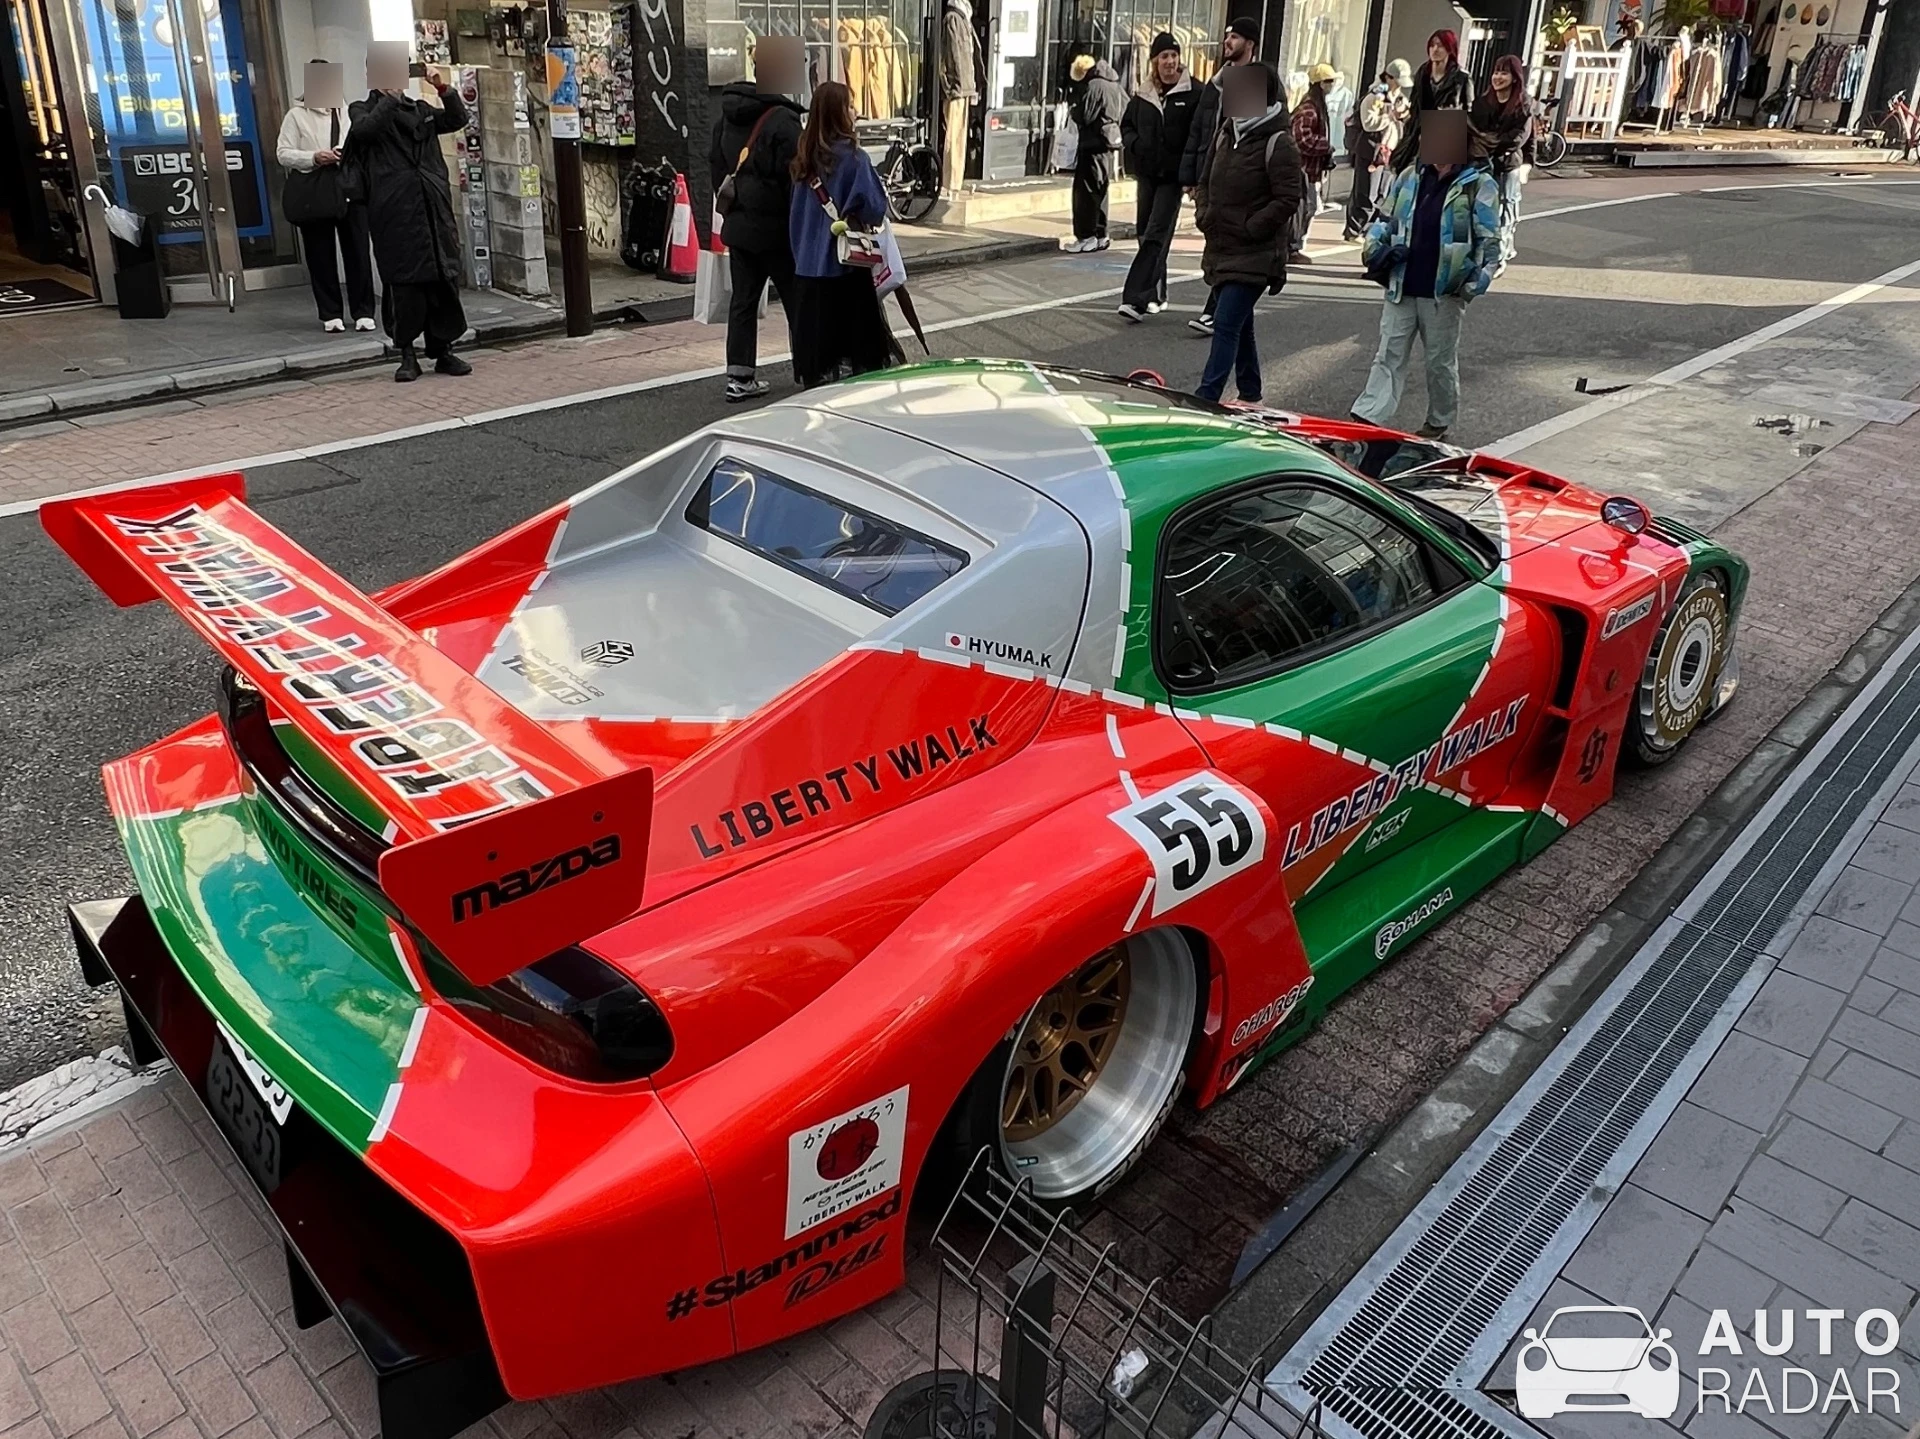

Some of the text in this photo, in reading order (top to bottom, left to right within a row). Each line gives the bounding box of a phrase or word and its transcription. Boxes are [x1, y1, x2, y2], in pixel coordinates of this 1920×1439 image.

[968, 636, 1053, 669] HYUMA.K
[690, 712, 1000, 860] LIBERTY WALK
[1280, 692, 1530, 873] LIBERTY WALK
[1134, 782, 1253, 891] 55
[1374, 886, 1454, 961] ROHANA
[800, 1180, 887, 1230] LIBERTY WALK
